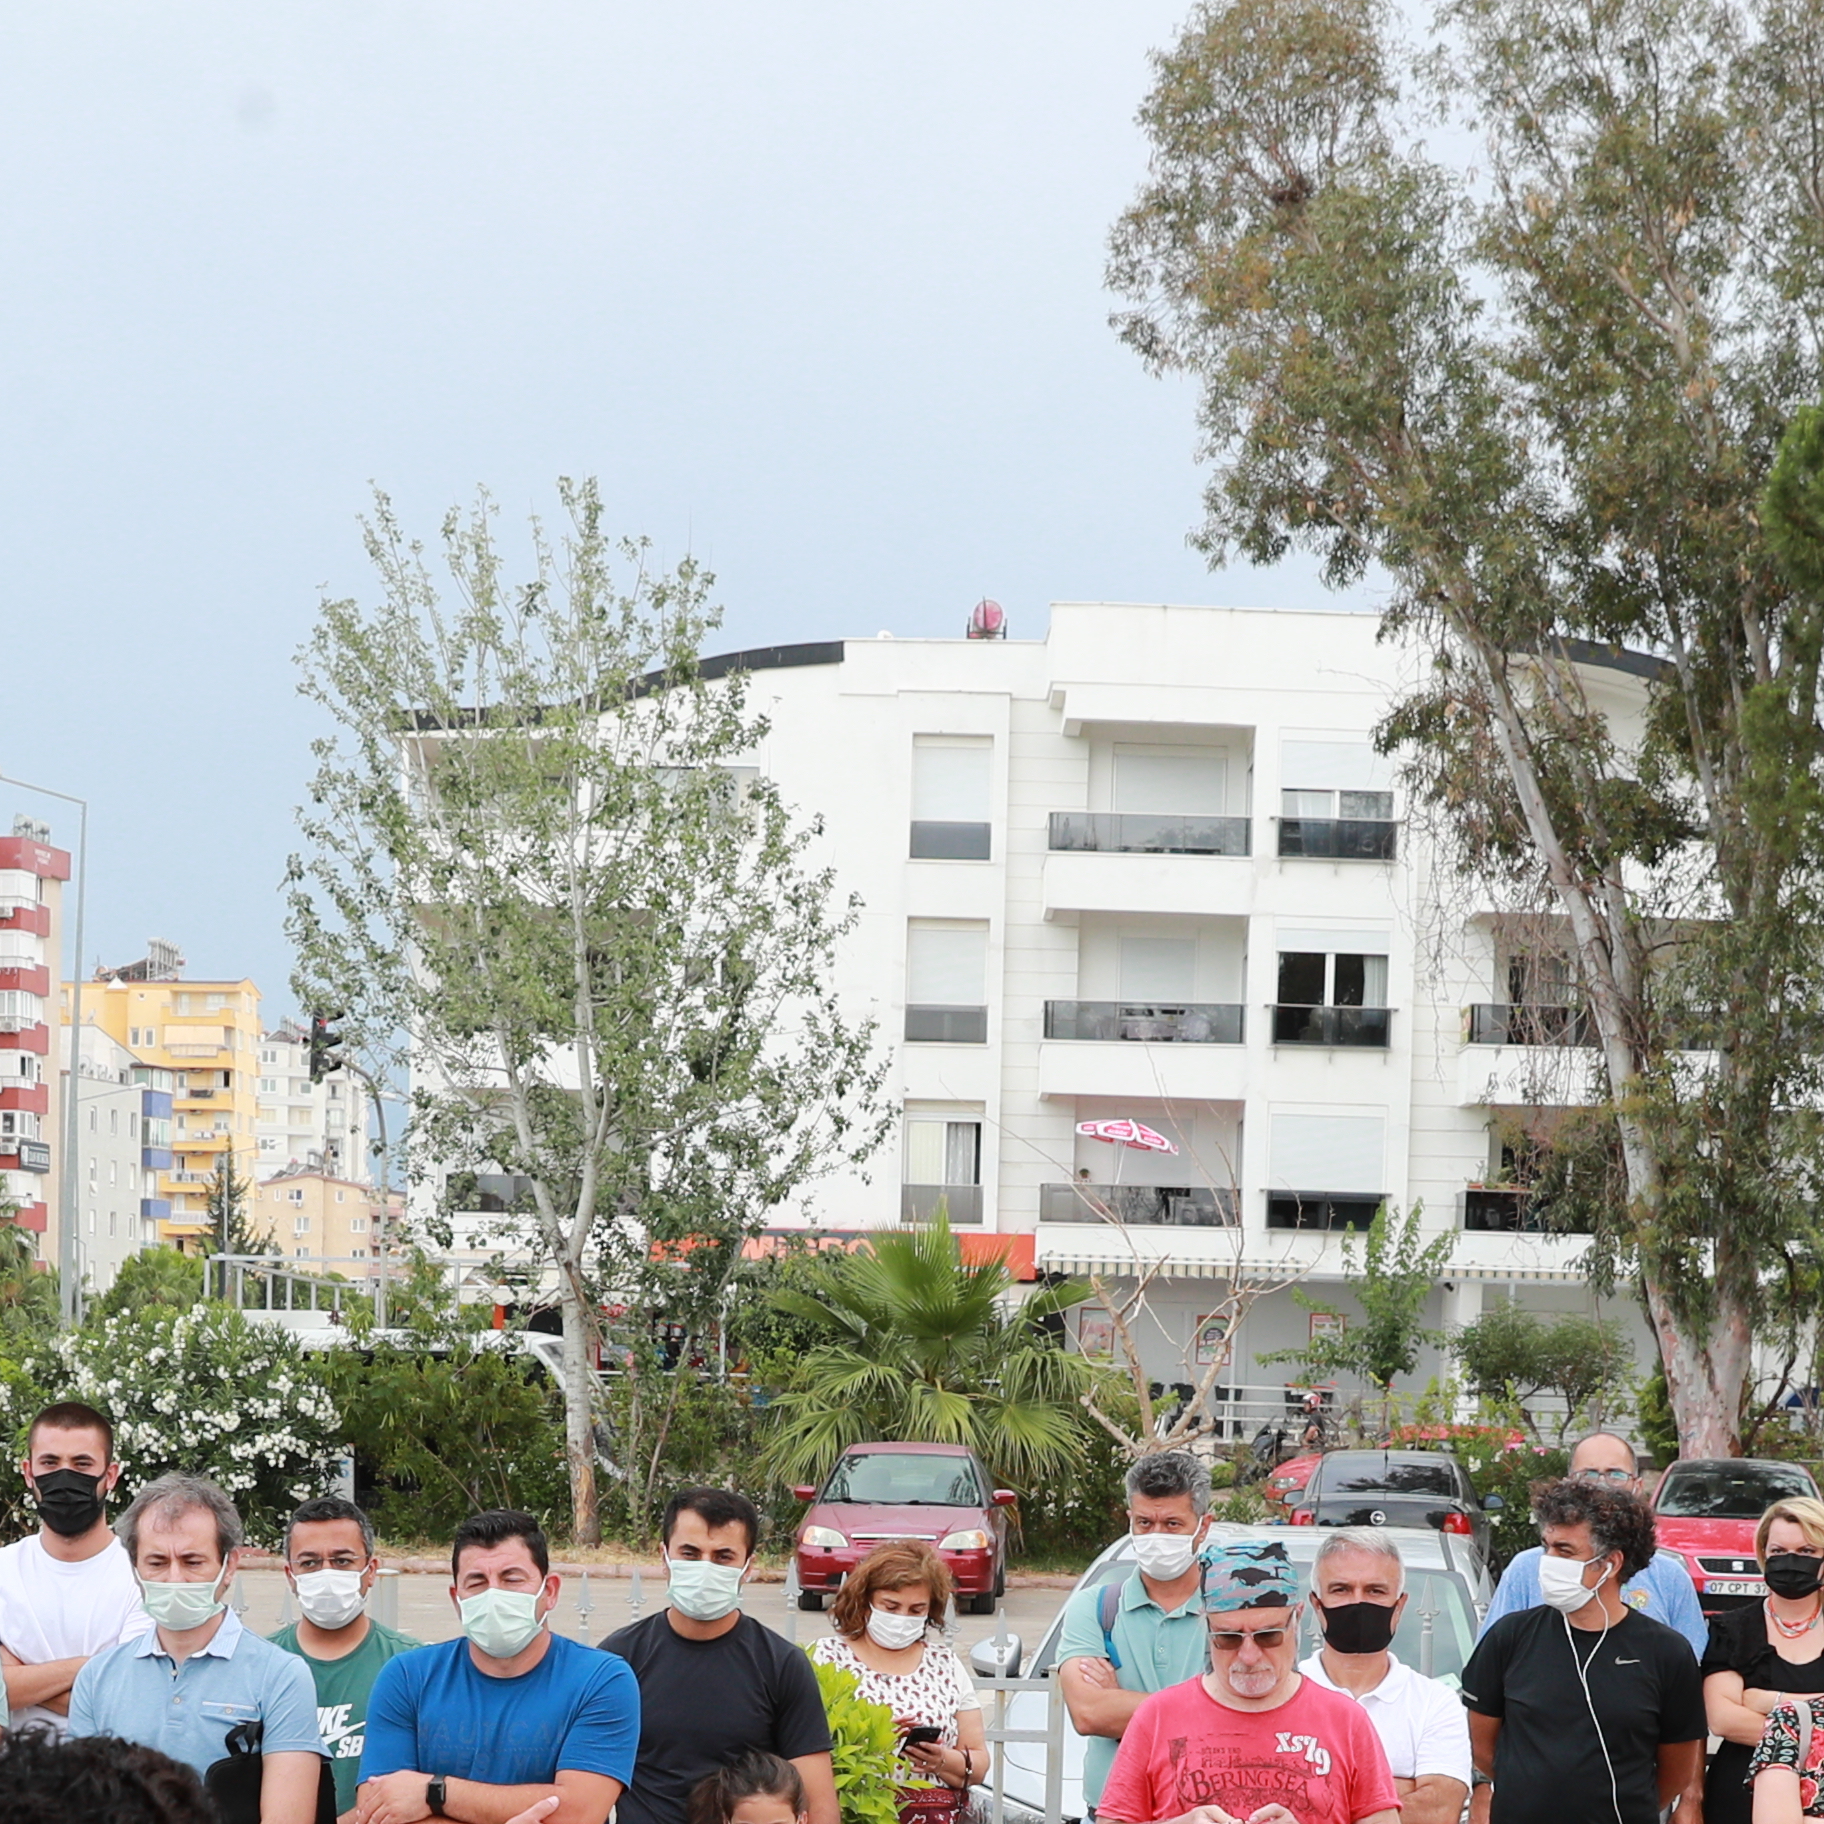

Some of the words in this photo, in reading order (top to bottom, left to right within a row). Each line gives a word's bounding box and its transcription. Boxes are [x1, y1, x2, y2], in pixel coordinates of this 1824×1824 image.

[1710, 1582, 1724, 1592] 07
[1728, 1583, 1749, 1593] CPT
[336, 1735, 365, 1758] SB
[1189, 1769, 1269, 1800] BERING
[1274, 1770, 1309, 1801] SEA
